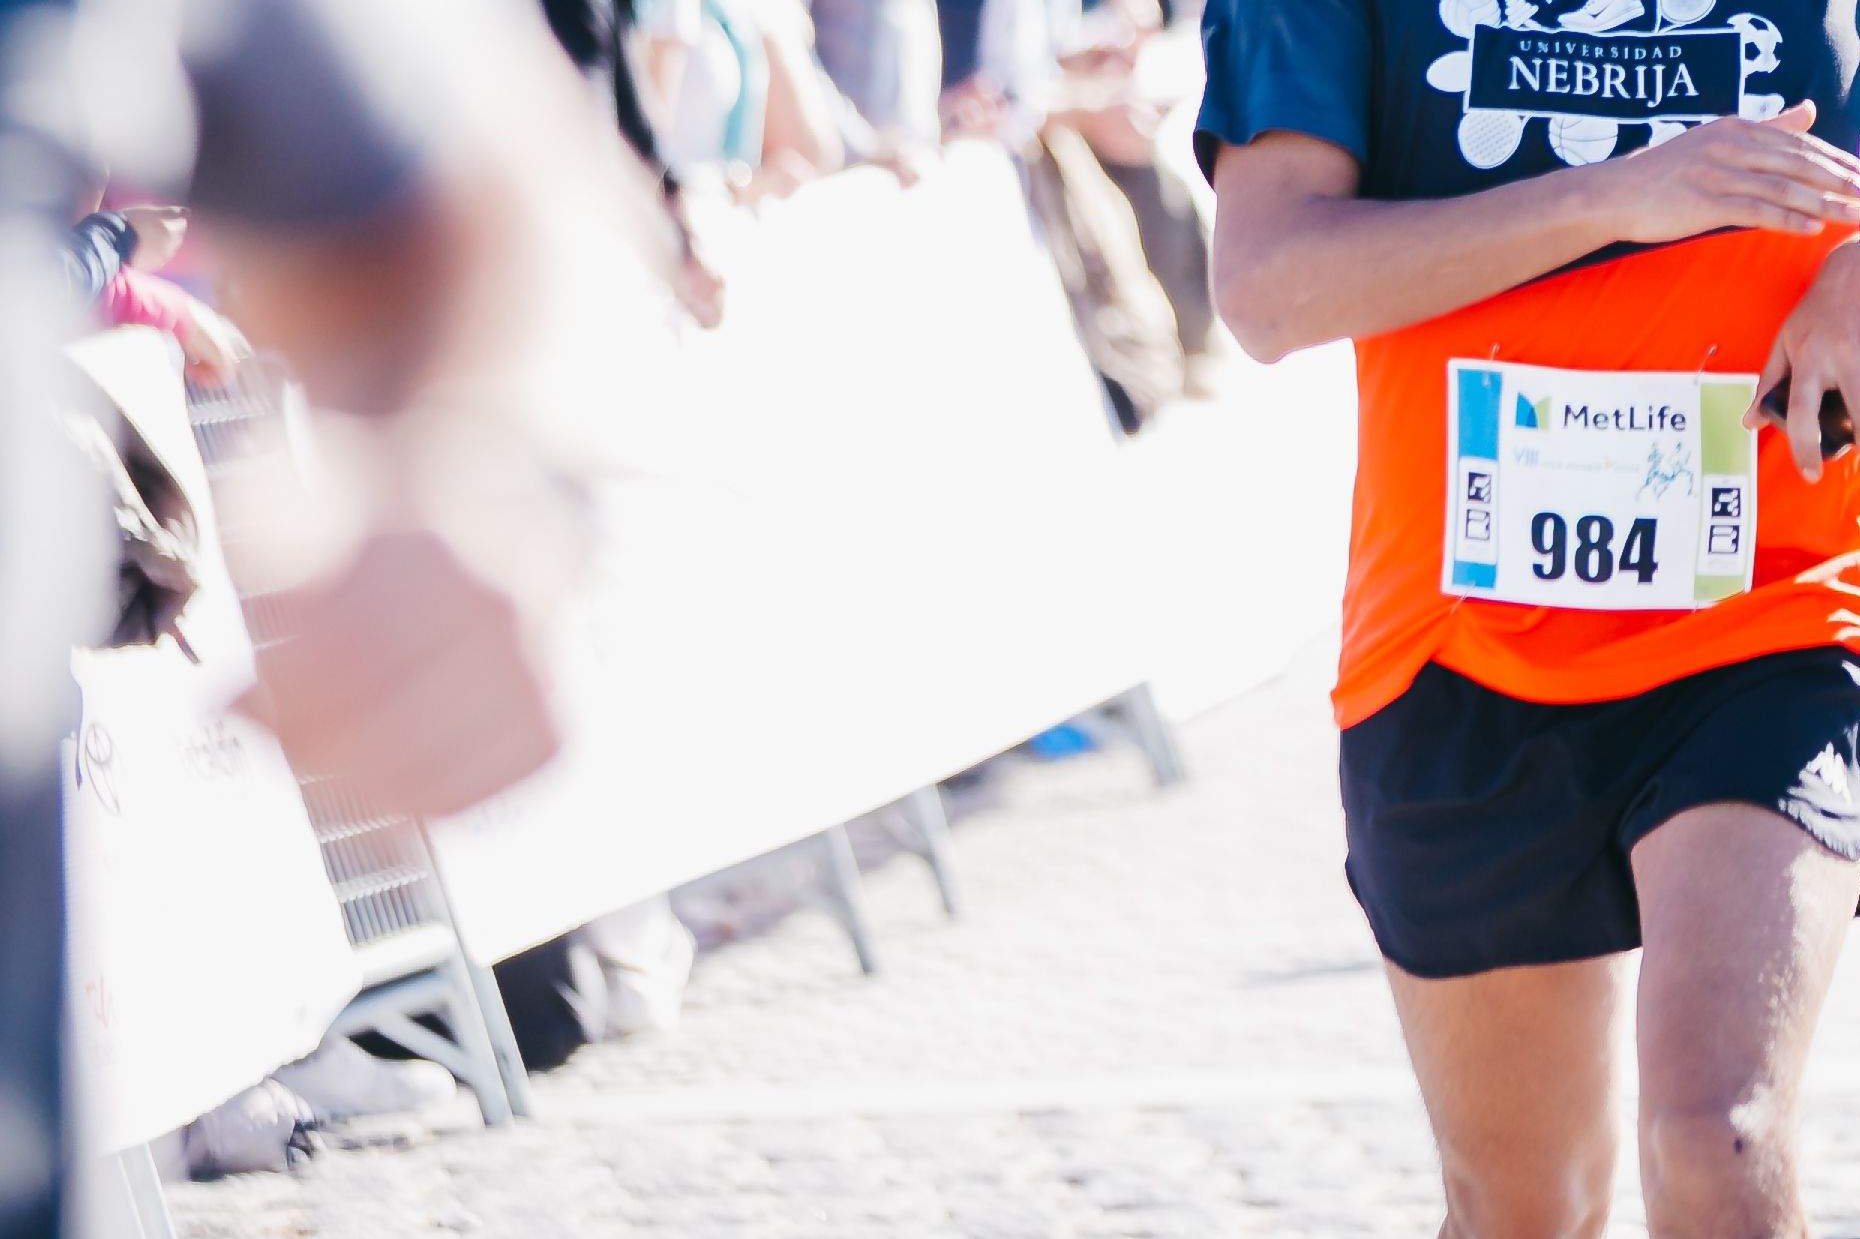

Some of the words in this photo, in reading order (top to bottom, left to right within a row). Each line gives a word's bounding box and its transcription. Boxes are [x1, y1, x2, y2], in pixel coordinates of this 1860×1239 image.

[1519, 40, 1682, 60] UNIVERSIDAD
[1507, 55, 1700, 108] NEBRIJA
[1563, 403, 1688, 432] MetLife
[1530, 511, 1659, 585] 984
